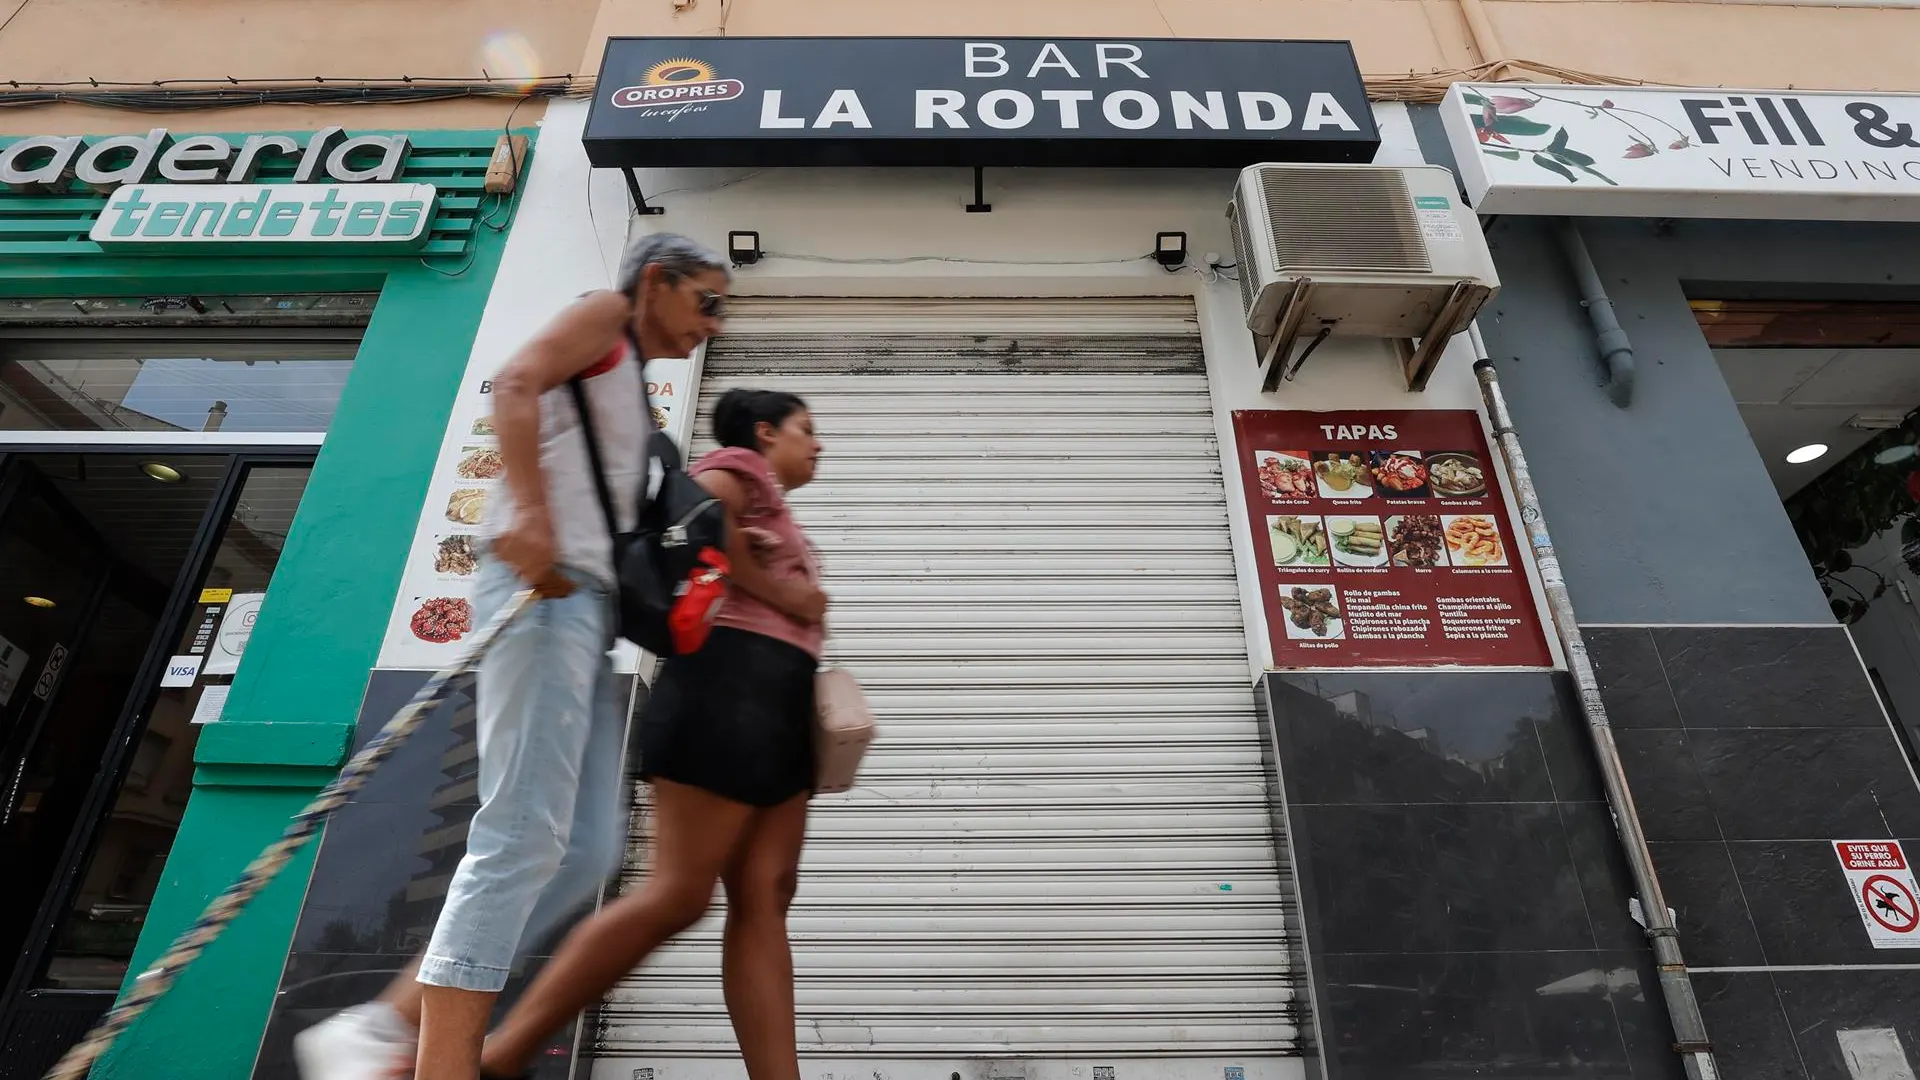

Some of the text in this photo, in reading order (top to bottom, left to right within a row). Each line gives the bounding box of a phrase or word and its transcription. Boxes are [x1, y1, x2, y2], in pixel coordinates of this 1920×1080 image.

[965, 42, 1150, 78] BAR
[626, 84, 728, 101] OROPRES
[760, 89, 1360, 131] LA ROTONDA
[1680, 97, 1920, 148] Fill &
[110, 188, 424, 237] tendetes
[1320, 424, 1398, 440] TAPAS
[171, 666, 195, 676] VISA
[1878, 858, 1900, 867] AQUÍ
